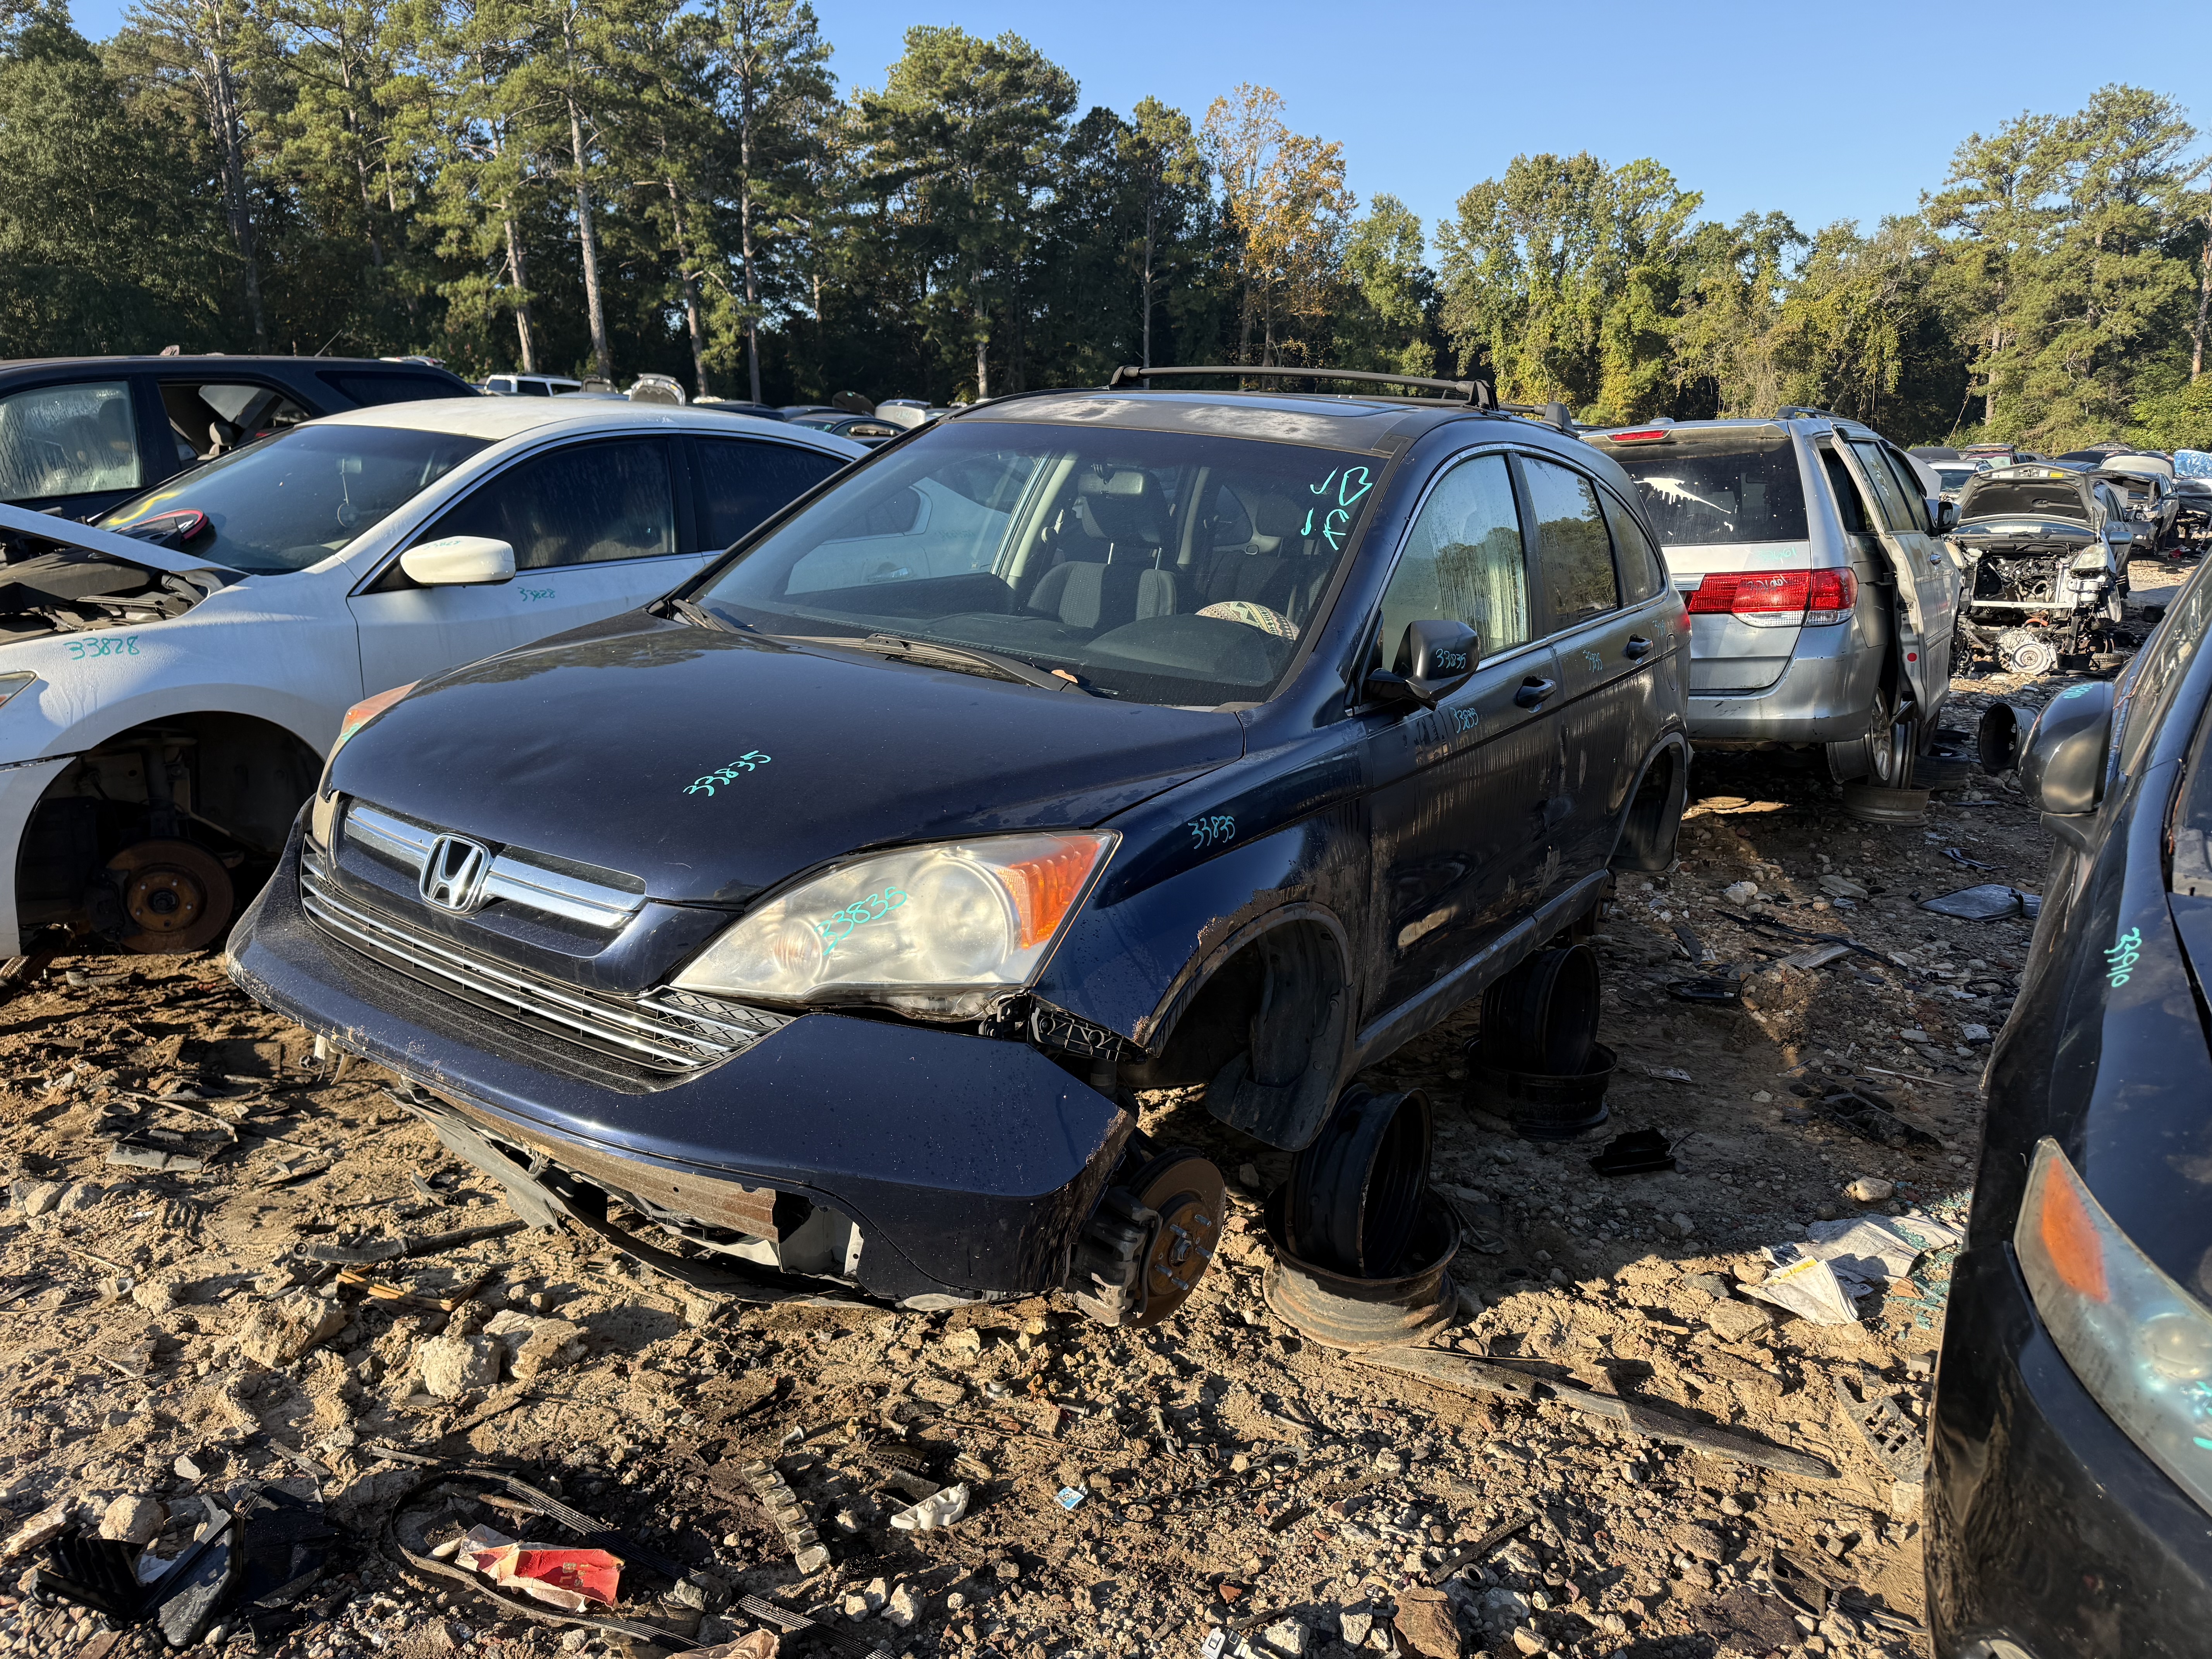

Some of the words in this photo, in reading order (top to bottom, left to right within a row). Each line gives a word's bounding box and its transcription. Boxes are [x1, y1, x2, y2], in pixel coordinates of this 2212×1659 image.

[63, 635, 140, 660] 33828
[1436, 648, 1466, 669] 33835
[682, 750, 771, 797] 33835
[1187, 815, 1235, 849] 33835
[814, 886, 907, 956] 33835
[2103, 927, 2142, 988] 33910
